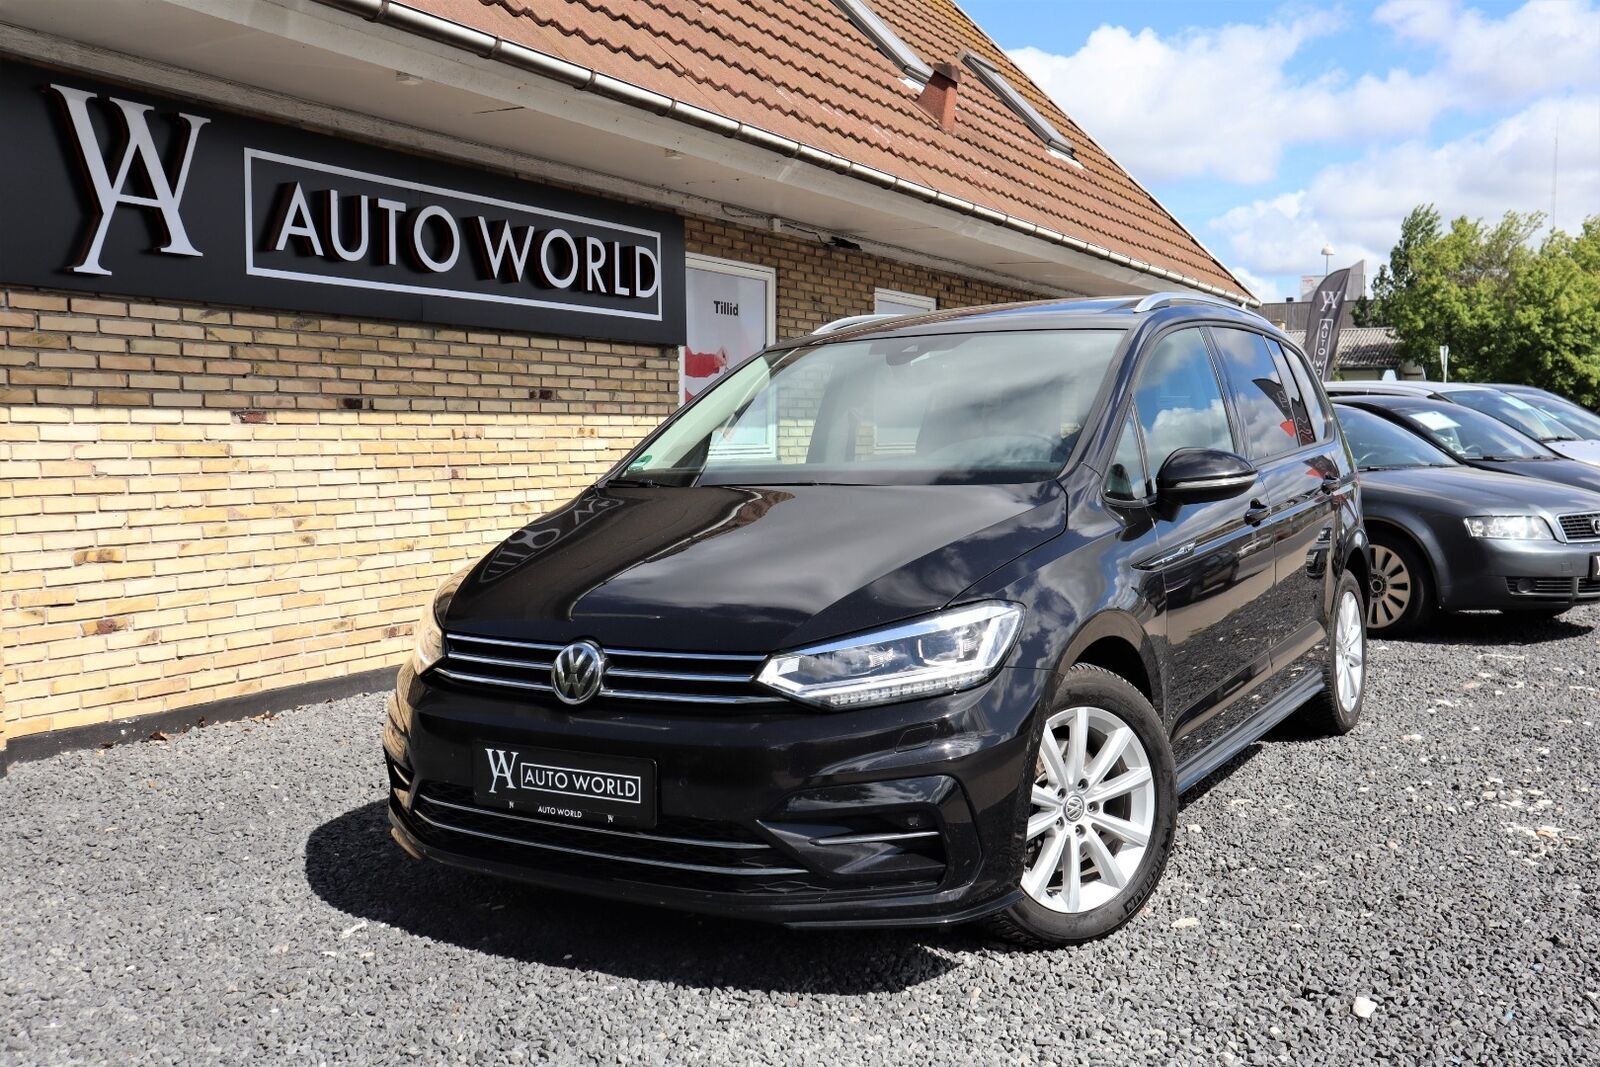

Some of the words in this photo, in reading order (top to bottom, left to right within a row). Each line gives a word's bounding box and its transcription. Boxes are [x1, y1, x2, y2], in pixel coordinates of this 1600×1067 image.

[275, 180, 461, 273] AUTO
[477, 215, 659, 299] WORLD
[713, 300, 739, 317] Tillid
[1318, 322, 1329, 356] AUTO
[524, 768, 568, 789] AUTO
[572, 774, 637, 797] WORLD
[537, 806, 556, 815] AUTO
[558, 808, 582, 818] WORLD
